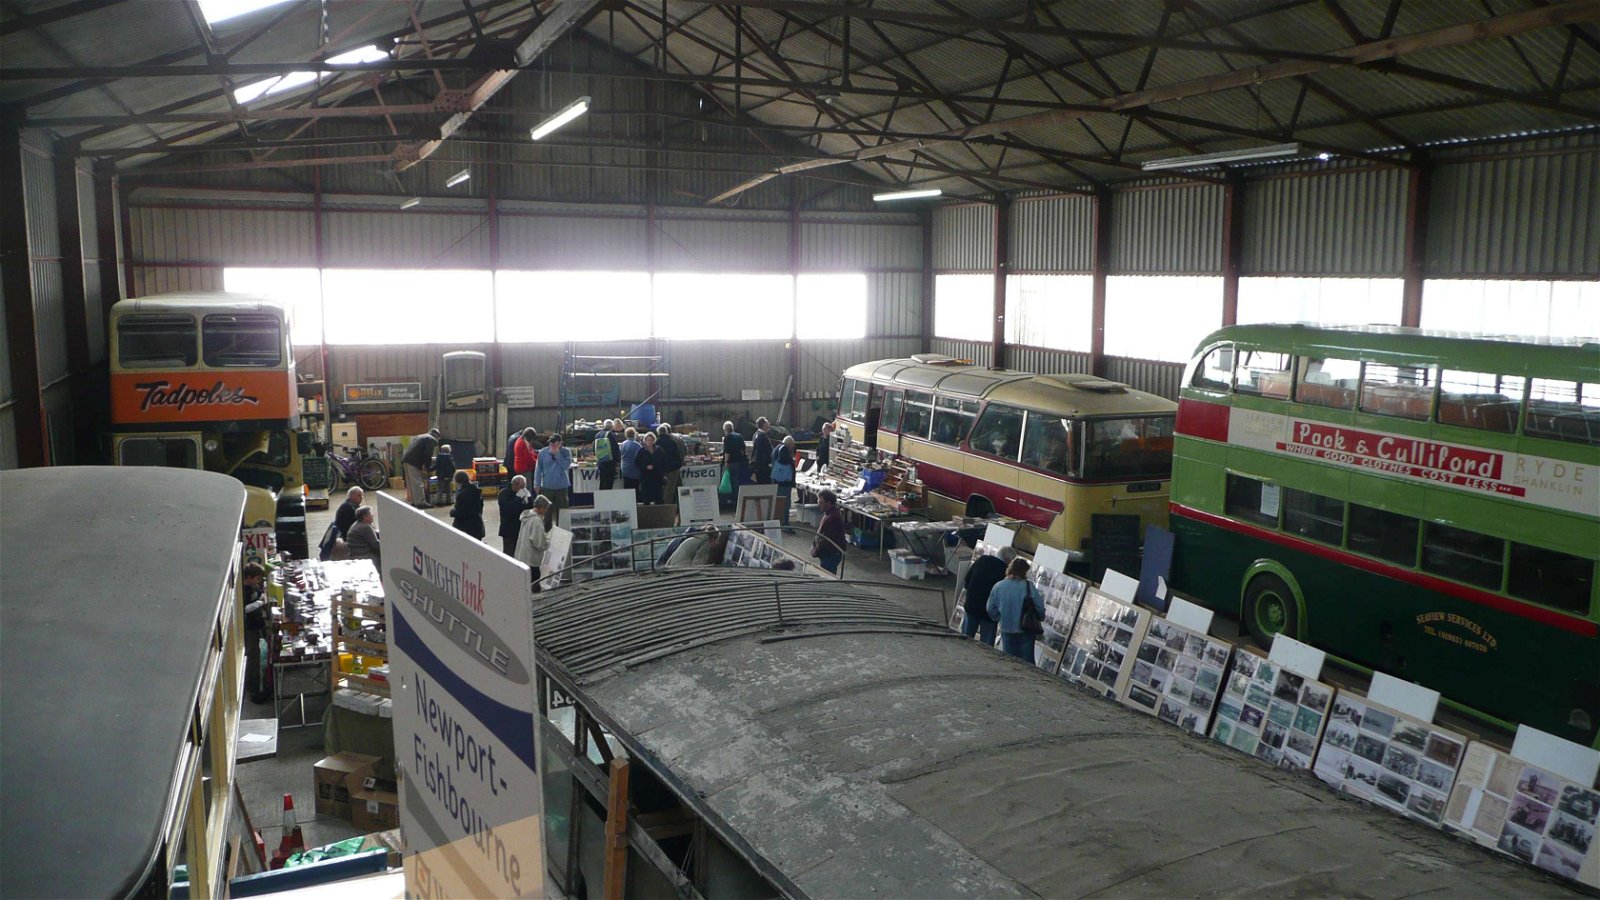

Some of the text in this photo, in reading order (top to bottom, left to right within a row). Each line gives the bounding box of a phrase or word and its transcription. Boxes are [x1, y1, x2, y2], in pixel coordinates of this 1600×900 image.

[135, 380, 259, 412] Tadpoles
[1286, 443, 1317, 457] WHERE
[1323, 450, 1355, 464] GOOD
[1361, 458, 1412, 475] CLOTHES
[1421, 469, 1455, 484] COST
[1299, 423, 1346, 450] Pack
[1356, 439, 1369, 454] &
[1377, 437, 1497, 478] Culliford
[1516, 457, 1585, 481] RYDE
[243, 533, 268, 549] XIT
[400, 579, 511, 675] SHUTTLE
[1416, 612, 1446, 624] SEAVIEW
[1447, 613, 1483, 635] SERVICES
[414, 671, 508, 796] Newport-
[414, 732, 521, 897] Fishbourne
